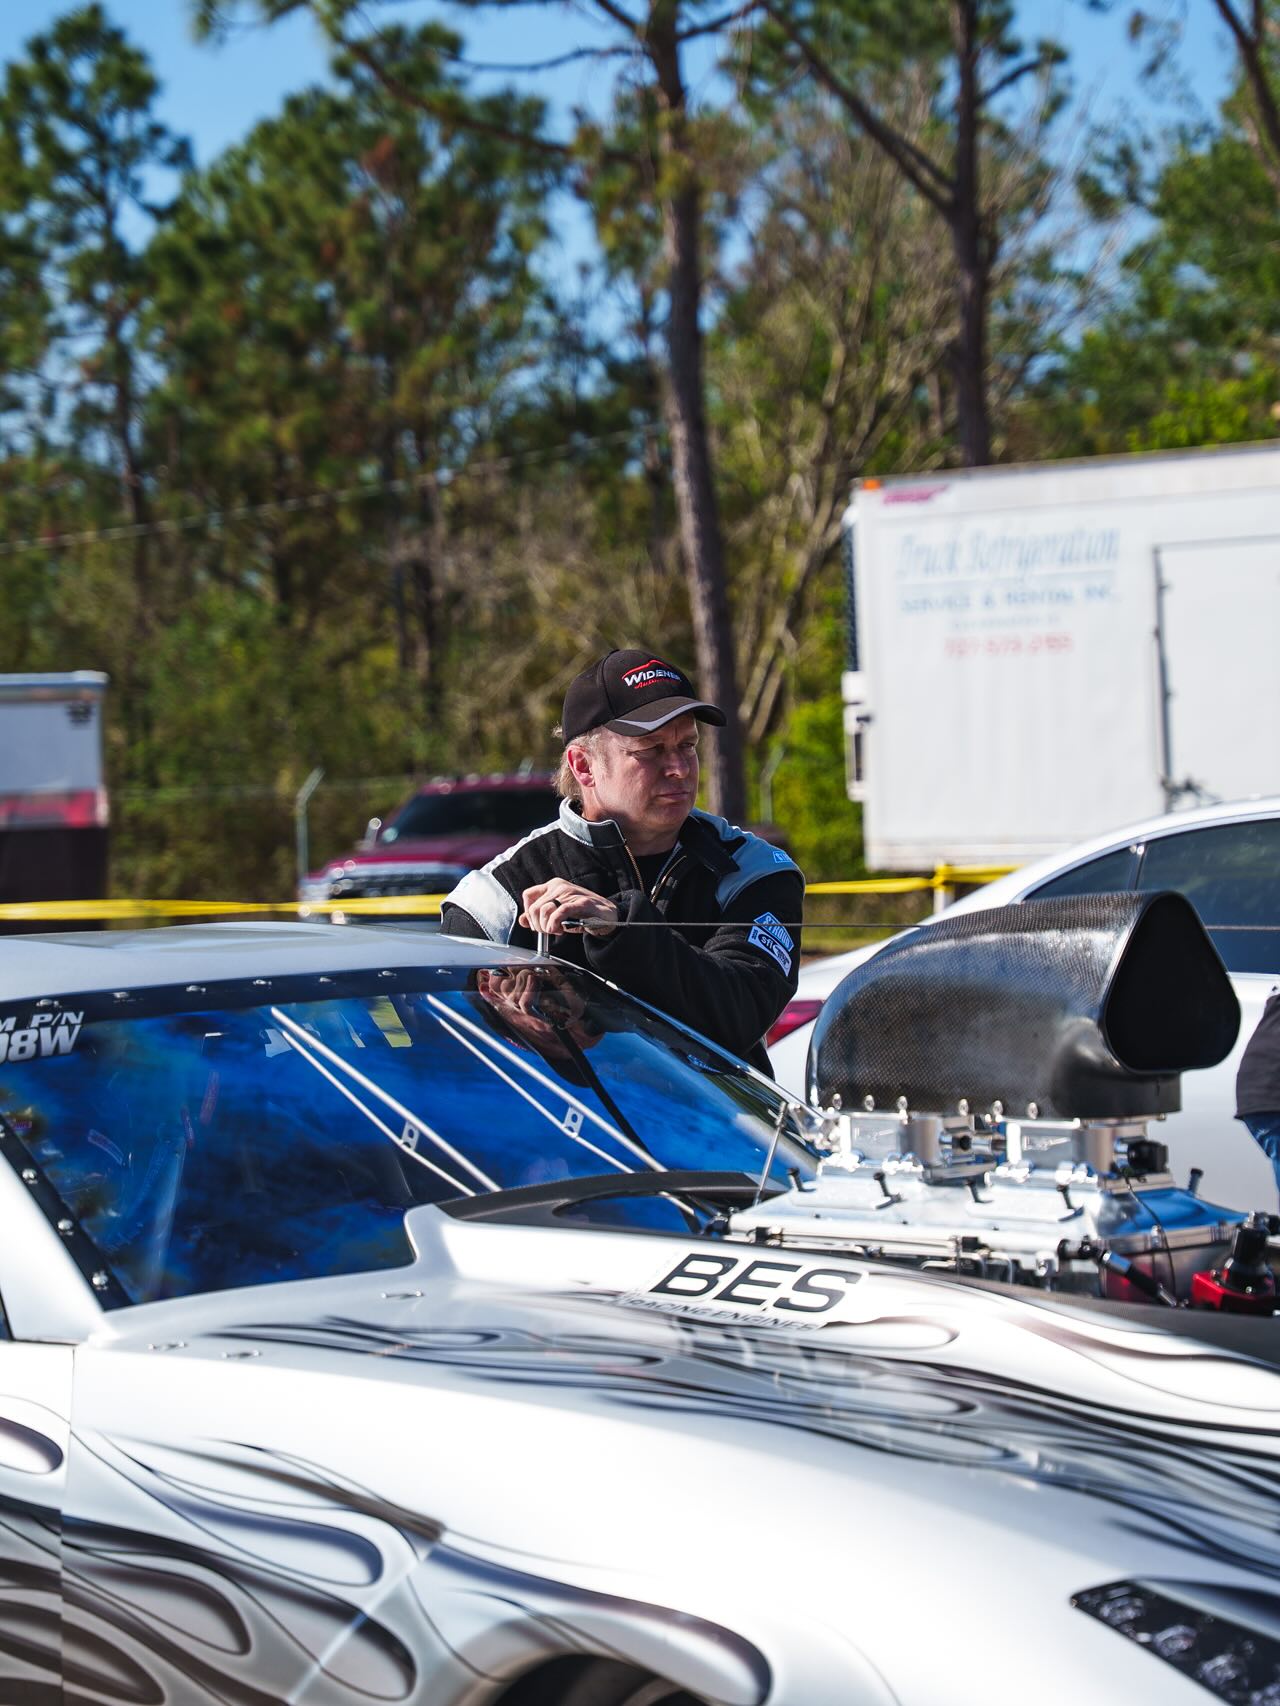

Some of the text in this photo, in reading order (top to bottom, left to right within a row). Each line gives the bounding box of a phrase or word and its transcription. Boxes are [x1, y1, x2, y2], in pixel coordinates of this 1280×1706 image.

[965, 528, 1121, 583] Refrigeration
[30, 1011, 84, 1028] P/N
[650, 1253, 862, 1313] BES
[628, 1299, 711, 1316] RACING
